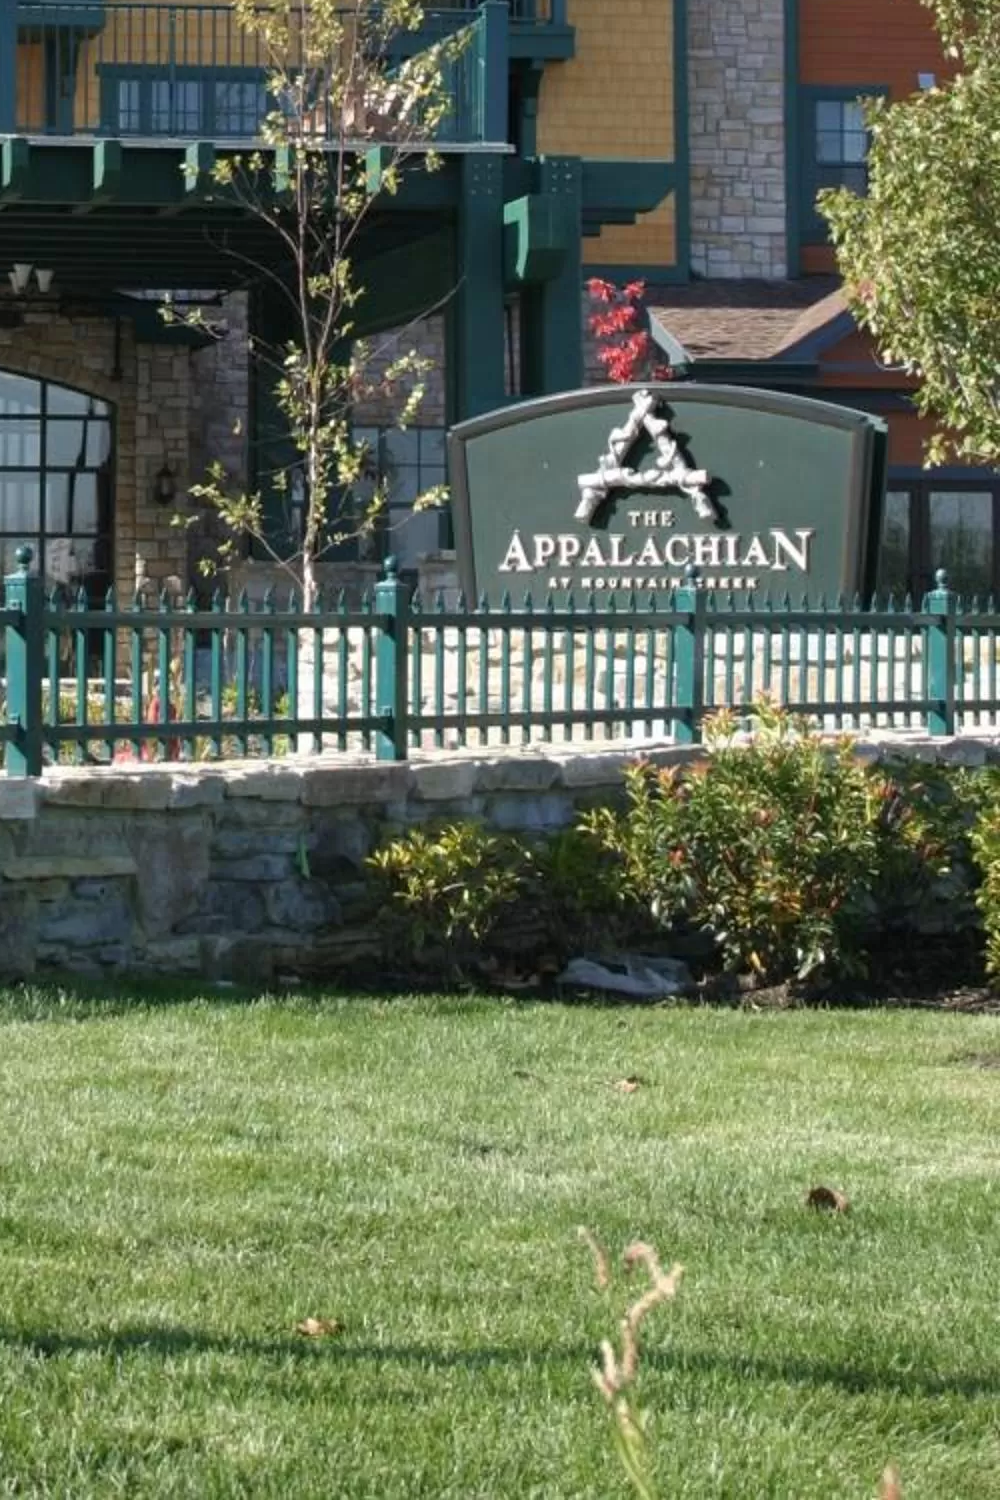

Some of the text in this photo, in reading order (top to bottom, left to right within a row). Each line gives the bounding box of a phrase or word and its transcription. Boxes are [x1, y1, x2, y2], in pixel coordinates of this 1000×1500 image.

[627, 510, 674, 527] THE
[498, 528, 813, 571] APPALACHIAN
[548, 576, 571, 589] AT
